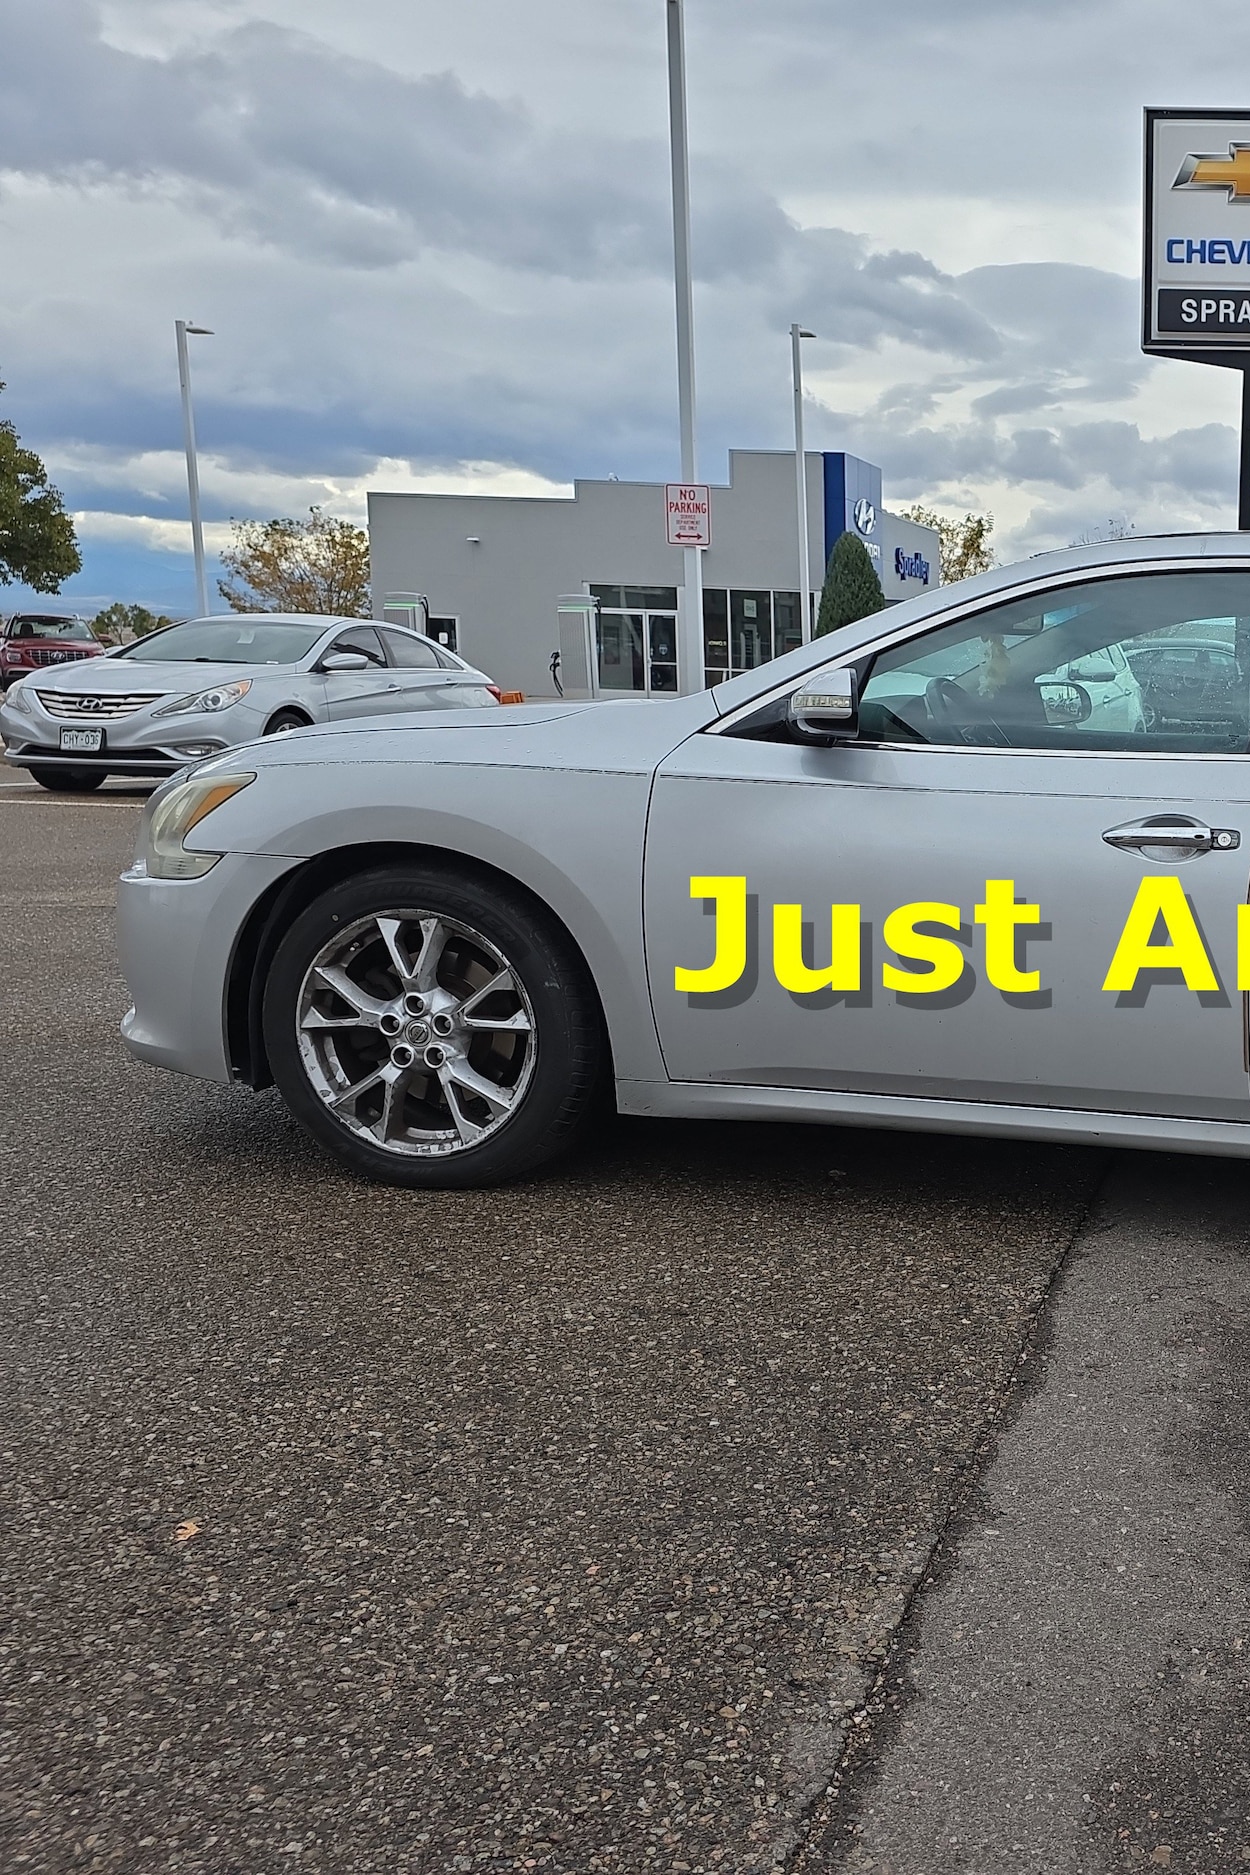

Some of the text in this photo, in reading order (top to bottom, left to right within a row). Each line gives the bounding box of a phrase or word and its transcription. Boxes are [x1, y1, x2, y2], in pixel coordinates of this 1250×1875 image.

[680, 489, 696, 501] NO
[669, 502, 707, 514] PARKING
[895, 547, 930, 585] Spradley
